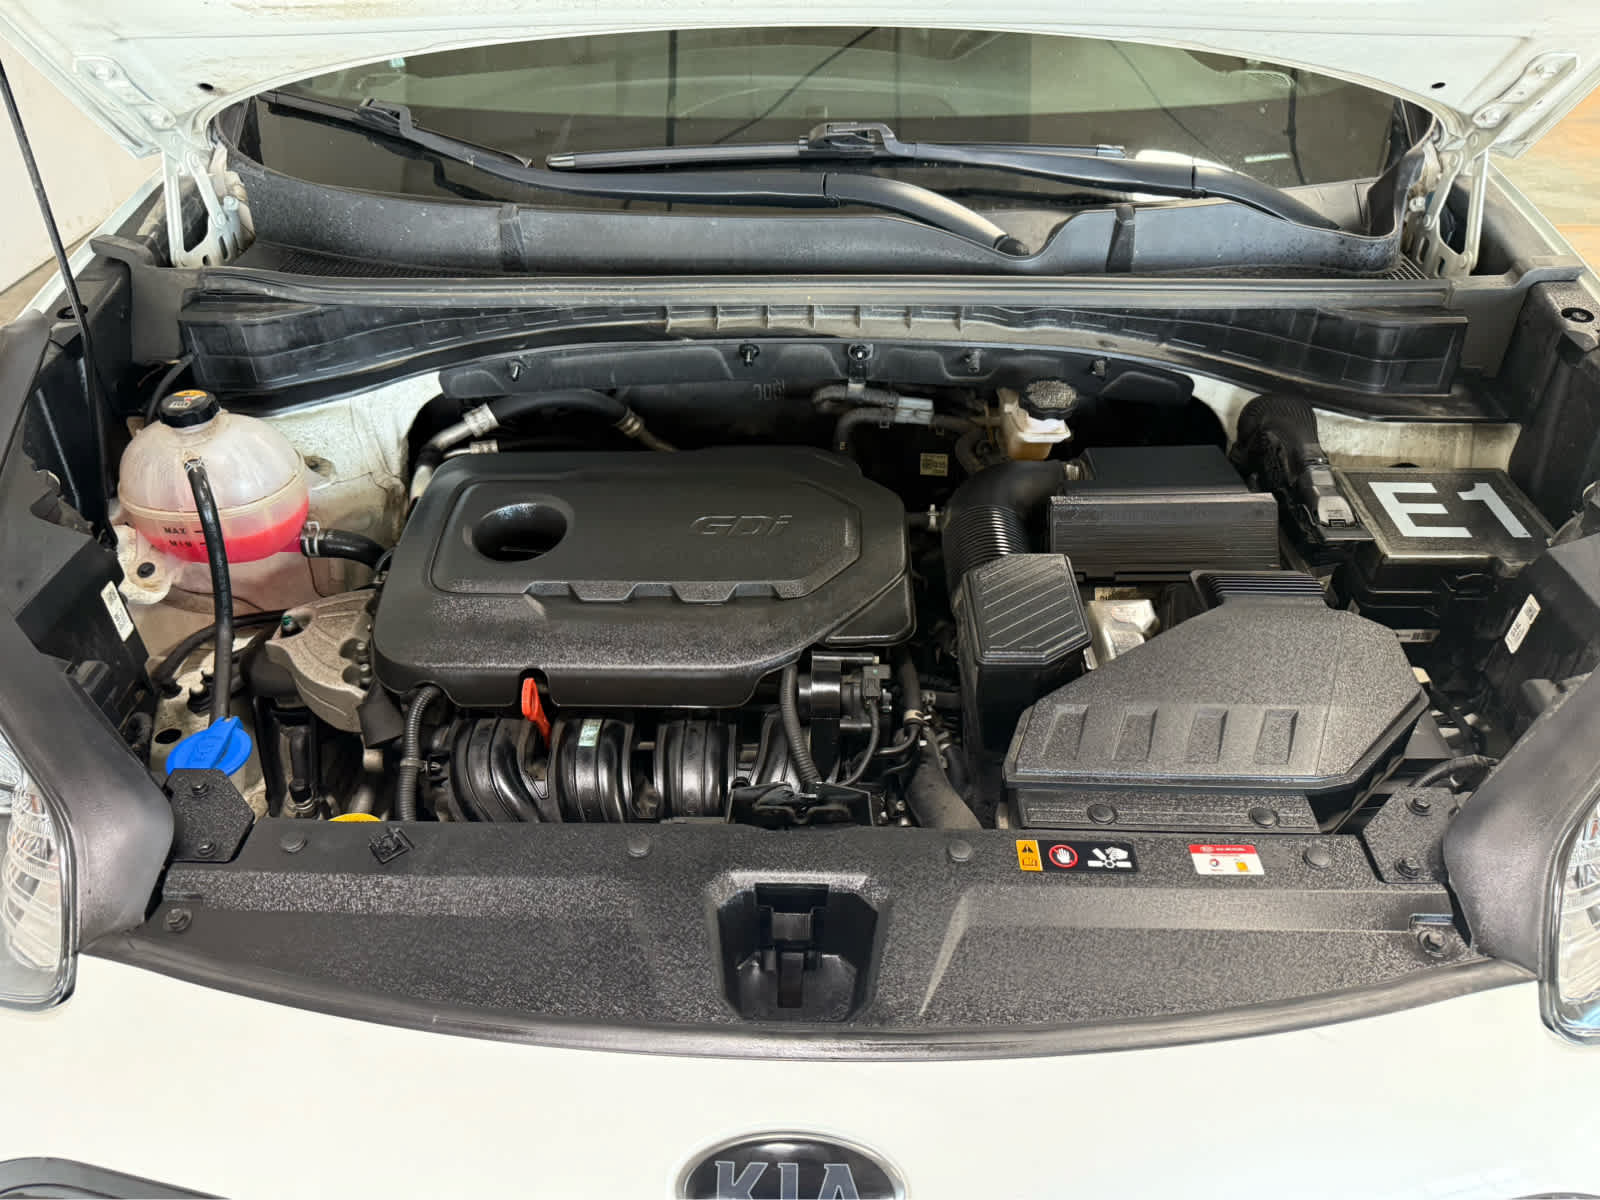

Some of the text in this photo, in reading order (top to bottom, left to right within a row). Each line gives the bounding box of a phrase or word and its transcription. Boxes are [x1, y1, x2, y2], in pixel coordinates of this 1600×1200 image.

[1367, 481, 1533, 539] E1
[163, 527, 187, 535] MAX
[169, 540, 193, 548] MIN
[714, 1160, 861, 1200] KIA
